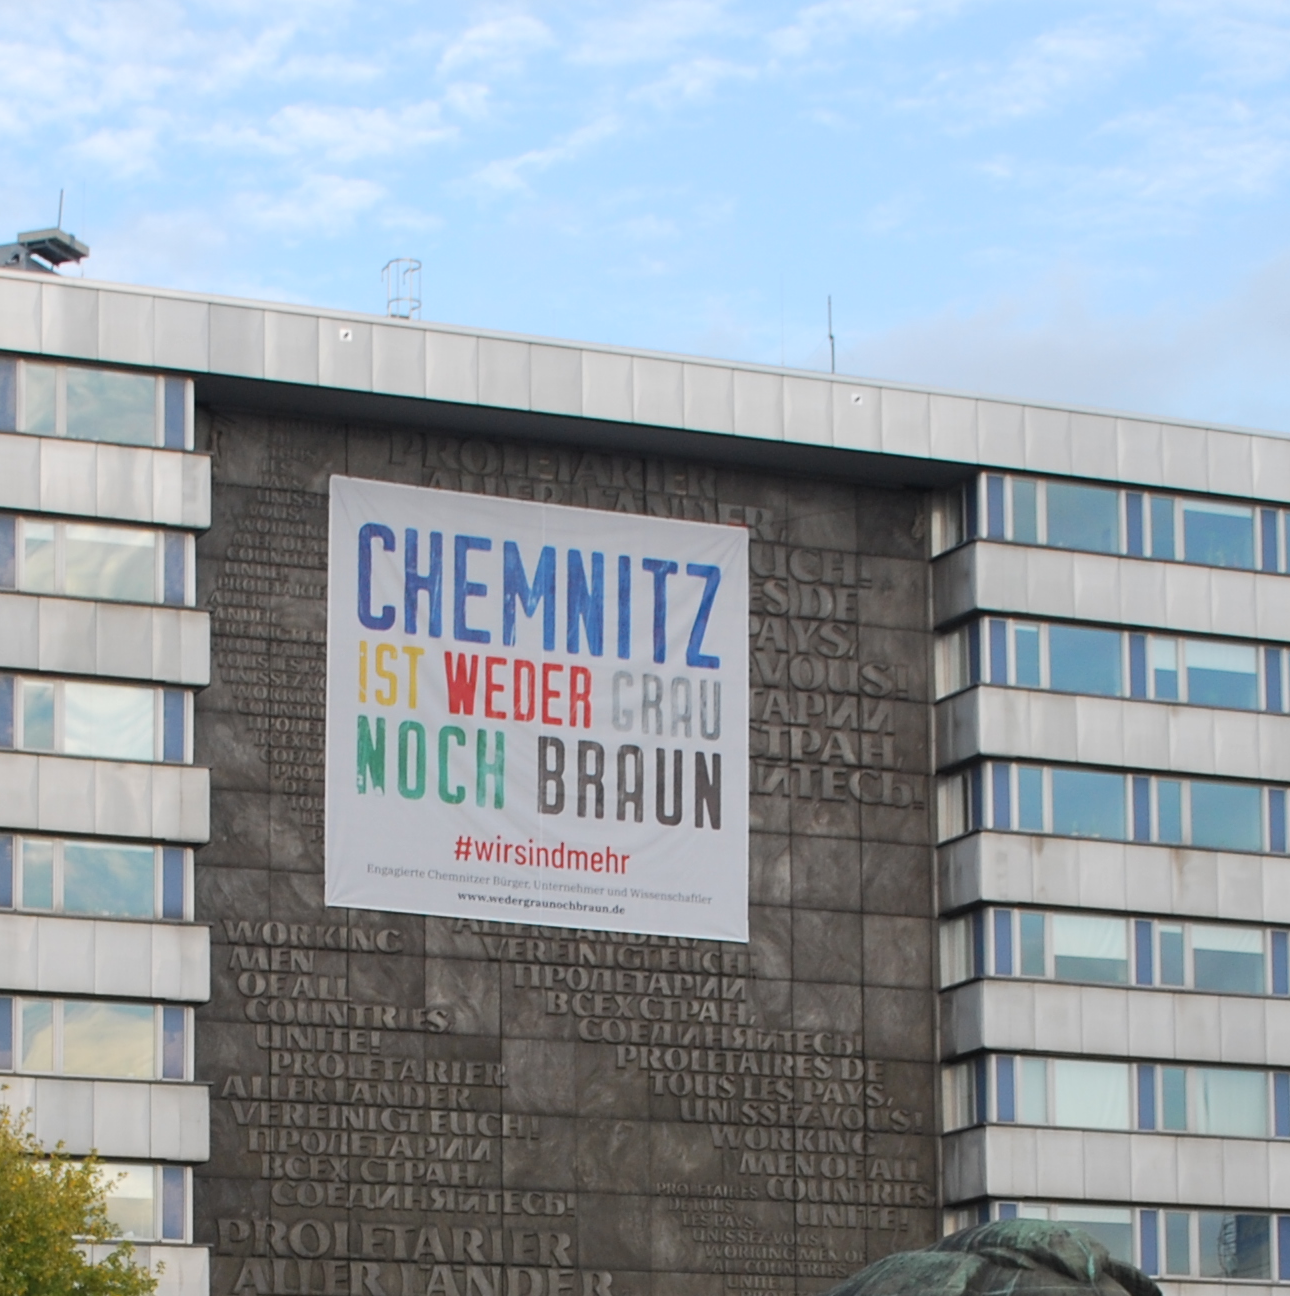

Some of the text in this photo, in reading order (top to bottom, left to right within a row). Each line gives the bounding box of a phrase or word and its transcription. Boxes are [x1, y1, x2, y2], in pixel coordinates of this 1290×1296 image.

[358, 522, 722, 669] CHEMNITZ
[357, 640, 722, 741] IST WEDER GRAU
[356, 715, 722, 830] NOCH BRAUN
[454, 835, 630, 875] #wirsindmehr
[367, 863, 426, 881] Engagierte
[427, 869, 490, 886] Chemnitzer
[533, 880, 605, 897] Unternehmer
[608, 887, 628, 898] und
[630, 888, 713, 905] Wissenschaftler
[458, 891, 627, 915] www.wedergraunochbraun.de
[223, 919, 401, 953] WORKING
[482, 935, 658, 972] VEREINIGT
[228, 946, 315, 975] MEN
[236, 971, 353, 1002] OF ALL
[513, 964, 747, 1001] ПРОЛЕТАРИИ
[545, 990, 758, 1026] ВСЕХ СТРАН,
[254, 1024, 382, 1056] UNITE!
[577, 1017, 863, 1057] СОЕДИНЯЙТЕСЬ!
[270, 1051, 509, 1089] PROLETARIER
[614, 1045, 885, 1083] PROLETAIRES DE
[221, 1075, 327, 1103] ALLER
[651, 1073, 894, 1109] TOUS LES PAYS,
[228, 1100, 540, 1141] VEREINIGT EUCH!
[679, 1099, 923, 1134] UNISSEZ-VOUS!
[247, 1127, 492, 1163] ПРОЛЕТАРИИ
[709, 1123, 877, 1157] WORKING
[259, 1155, 350, 1181] ВСЕХ
[737, 1151, 920, 1183] MEN OF ALL
[270, 1181, 577, 1217] СОЕДИНЯЙТЕСЬ!
[794, 1203, 911, 1232] UNITE!
[217, 1217, 575, 1268] PROLETARIER
[705, 1243, 866, 1264] WORKING MEN OF
